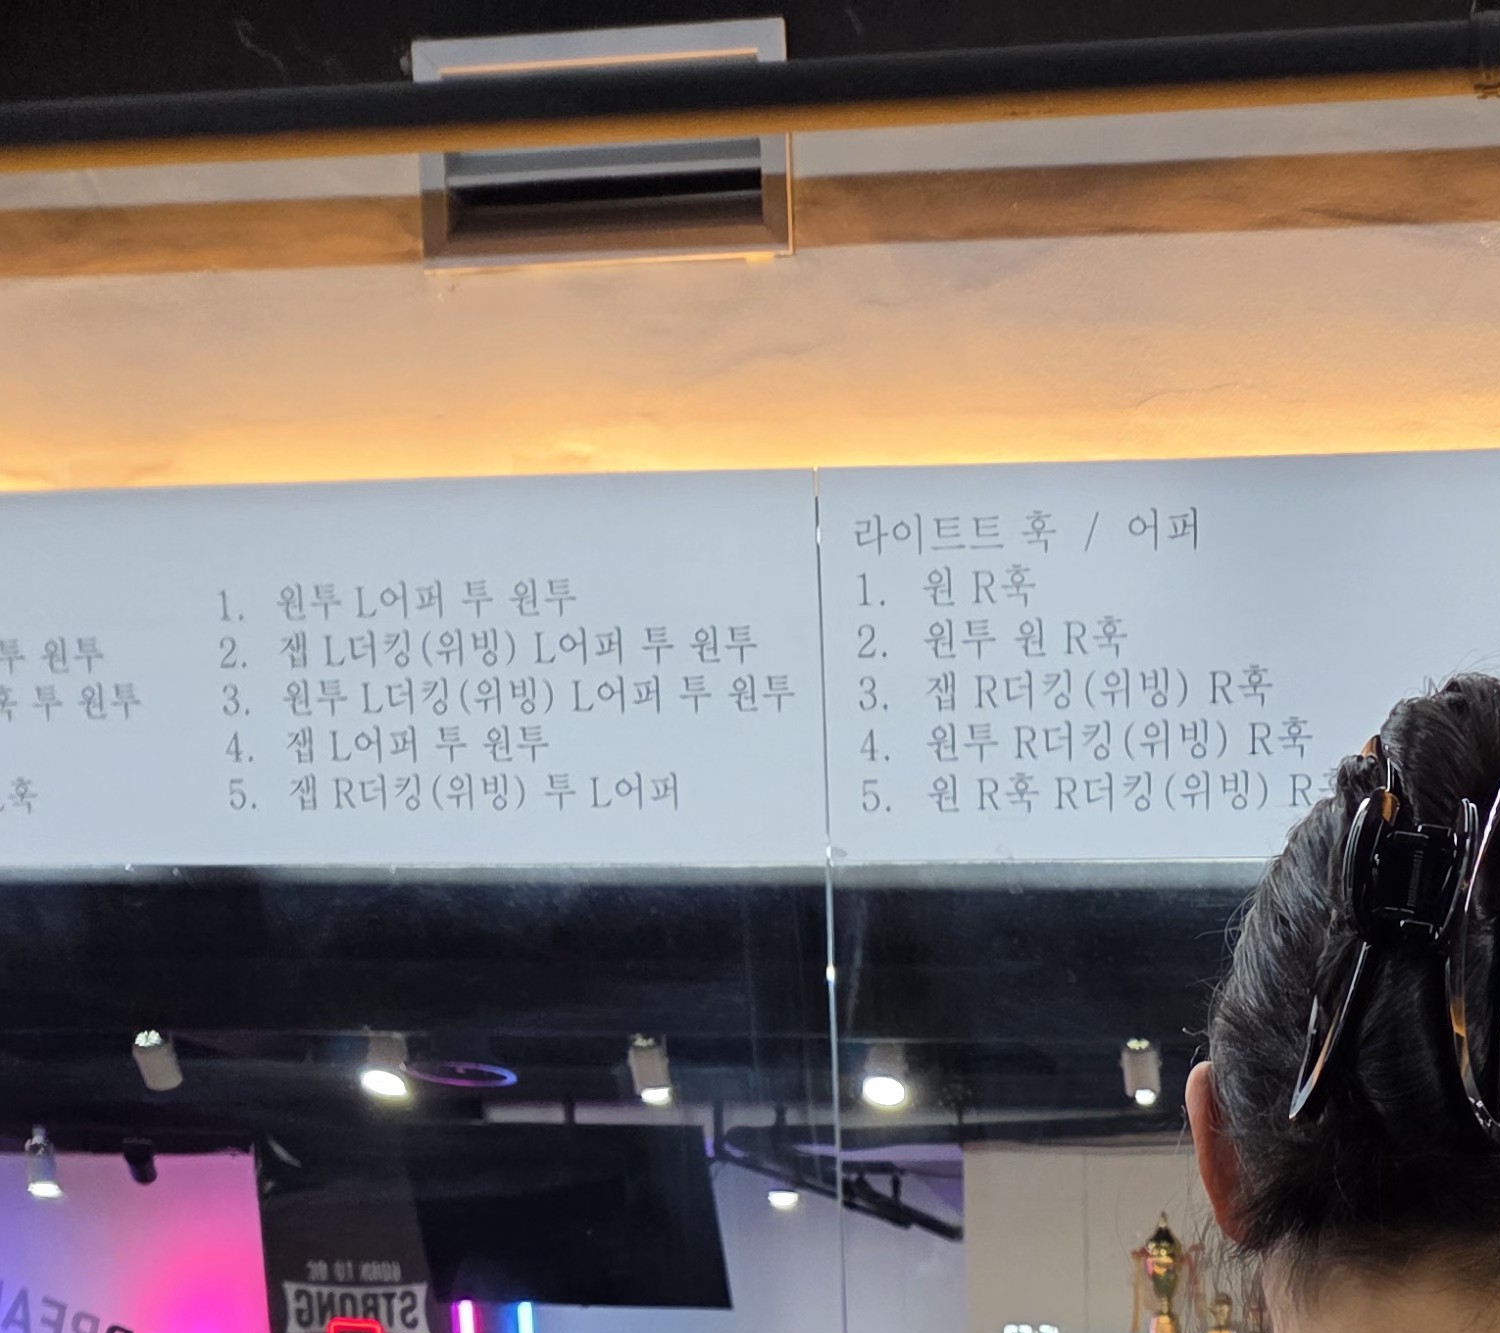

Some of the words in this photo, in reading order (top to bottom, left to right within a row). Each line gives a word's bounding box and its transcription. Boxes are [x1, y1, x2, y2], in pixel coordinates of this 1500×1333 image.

[853, 512, 1005, 557] 라이트트
[1021, 509, 1057, 554] 훅
[1127, 505, 1198, 552] 어퍼
[218, 589, 245, 622] 1.
[276, 582, 343, 622] 원투
[355, 579, 444, 620] L어퍼
[461, 579, 494, 619] 투
[508, 577, 577, 618] 원투
[856, 572, 886, 607] 1.
[922, 565, 956, 607] 원
[971, 563, 1037, 609] R훅
[219, 636, 247, 670] 2.
[279, 630, 308, 670] 잽
[323, 626, 516, 669] L더킹(위빙)
[533, 625, 623, 667] L어퍼
[641, 626, 675, 667] 투
[689, 624, 758, 666] 원투
[857, 623, 888, 660] 2.
[923, 617, 997, 661] 원투
[1013, 616, 1047, 659] 원
[1063, 615, 1128, 660] R훅
[222, 682, 251, 717] 3.
[283, 677, 349, 718] 원투
[361, 675, 554, 717] L더킹(위빙)
[571, 673, 661, 715] L어퍼
[678, 674, 713, 715] 투
[727, 673, 796, 713] 원투
[858, 675, 889, 713] 3.
[925, 669, 956, 713] 잽
[974, 666, 1189, 712] R더킹(위빙)
[1208, 663, 1274, 709] R훅
[225, 730, 254, 764] 4.
[286, 725, 314, 765] 잽
[328, 724, 418, 765] L어퍼
[434, 725, 468, 764] 투
[482, 723, 550, 764] 원투
[859, 728, 891, 763] 4.
[926, 721, 999, 764] 원투
[1013, 717, 1228, 763] R더킹(위빙)
[1247, 716, 1314, 761] R훅
[229, 777, 257, 811] 5.
[289, 771, 318, 813] 잽
[332, 772, 526, 812] R더킹(위빙)
[543, 772, 577, 812] 투
[589, 770, 679, 811] L어퍼
[861, 778, 892, 813] 5.
[927, 772, 961, 814] 원
[976, 771, 1040, 814] R훅
[1054, 768, 1269, 814] R더킹(위빙)
